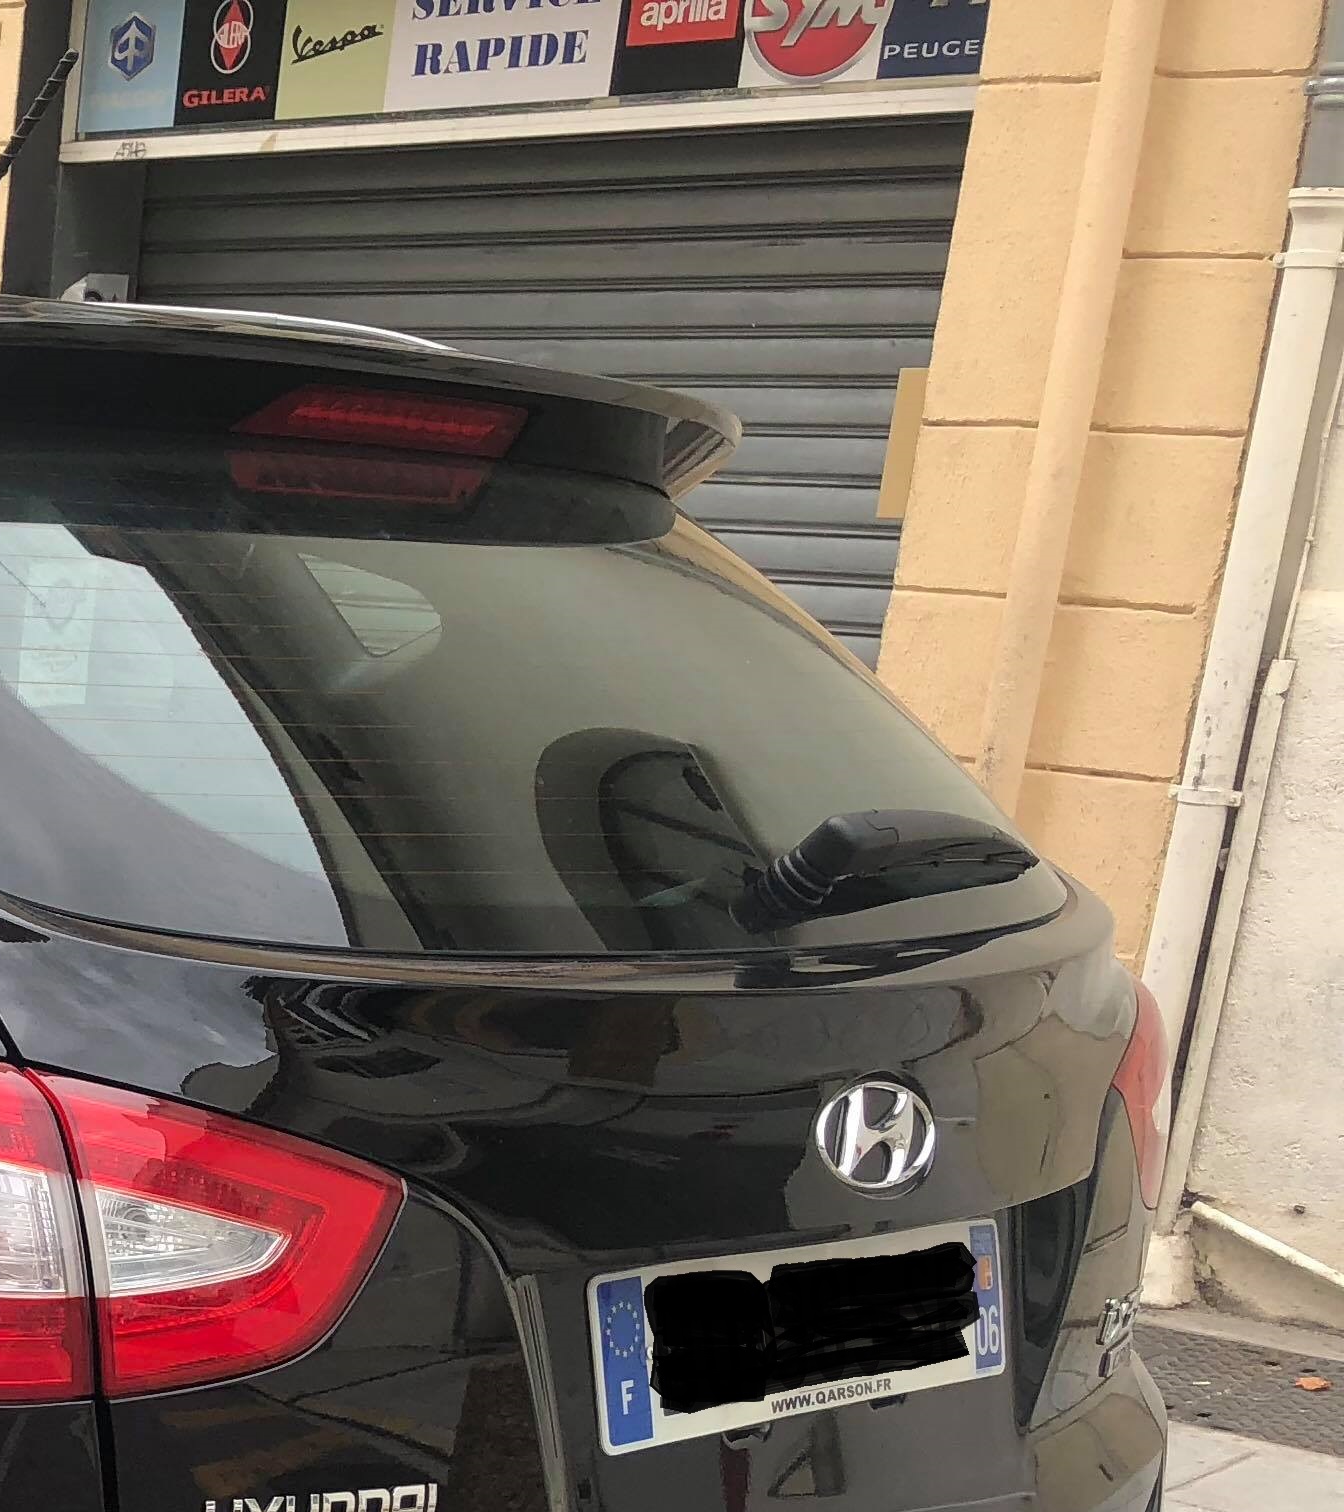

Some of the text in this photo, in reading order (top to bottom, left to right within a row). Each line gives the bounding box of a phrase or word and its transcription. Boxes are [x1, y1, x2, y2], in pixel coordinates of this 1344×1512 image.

[640, 0, 727, 31] aprilia
[290, 24, 383, 65] Vespa
[412, 30, 589, 76] RAPIDE
[182, 86, 267, 108] GILERA
[977, 1305, 999, 1355] 06
[620, 1379, 634, 1416] F
[771, 1378, 892, 1413] WWW.QARSON.FR
